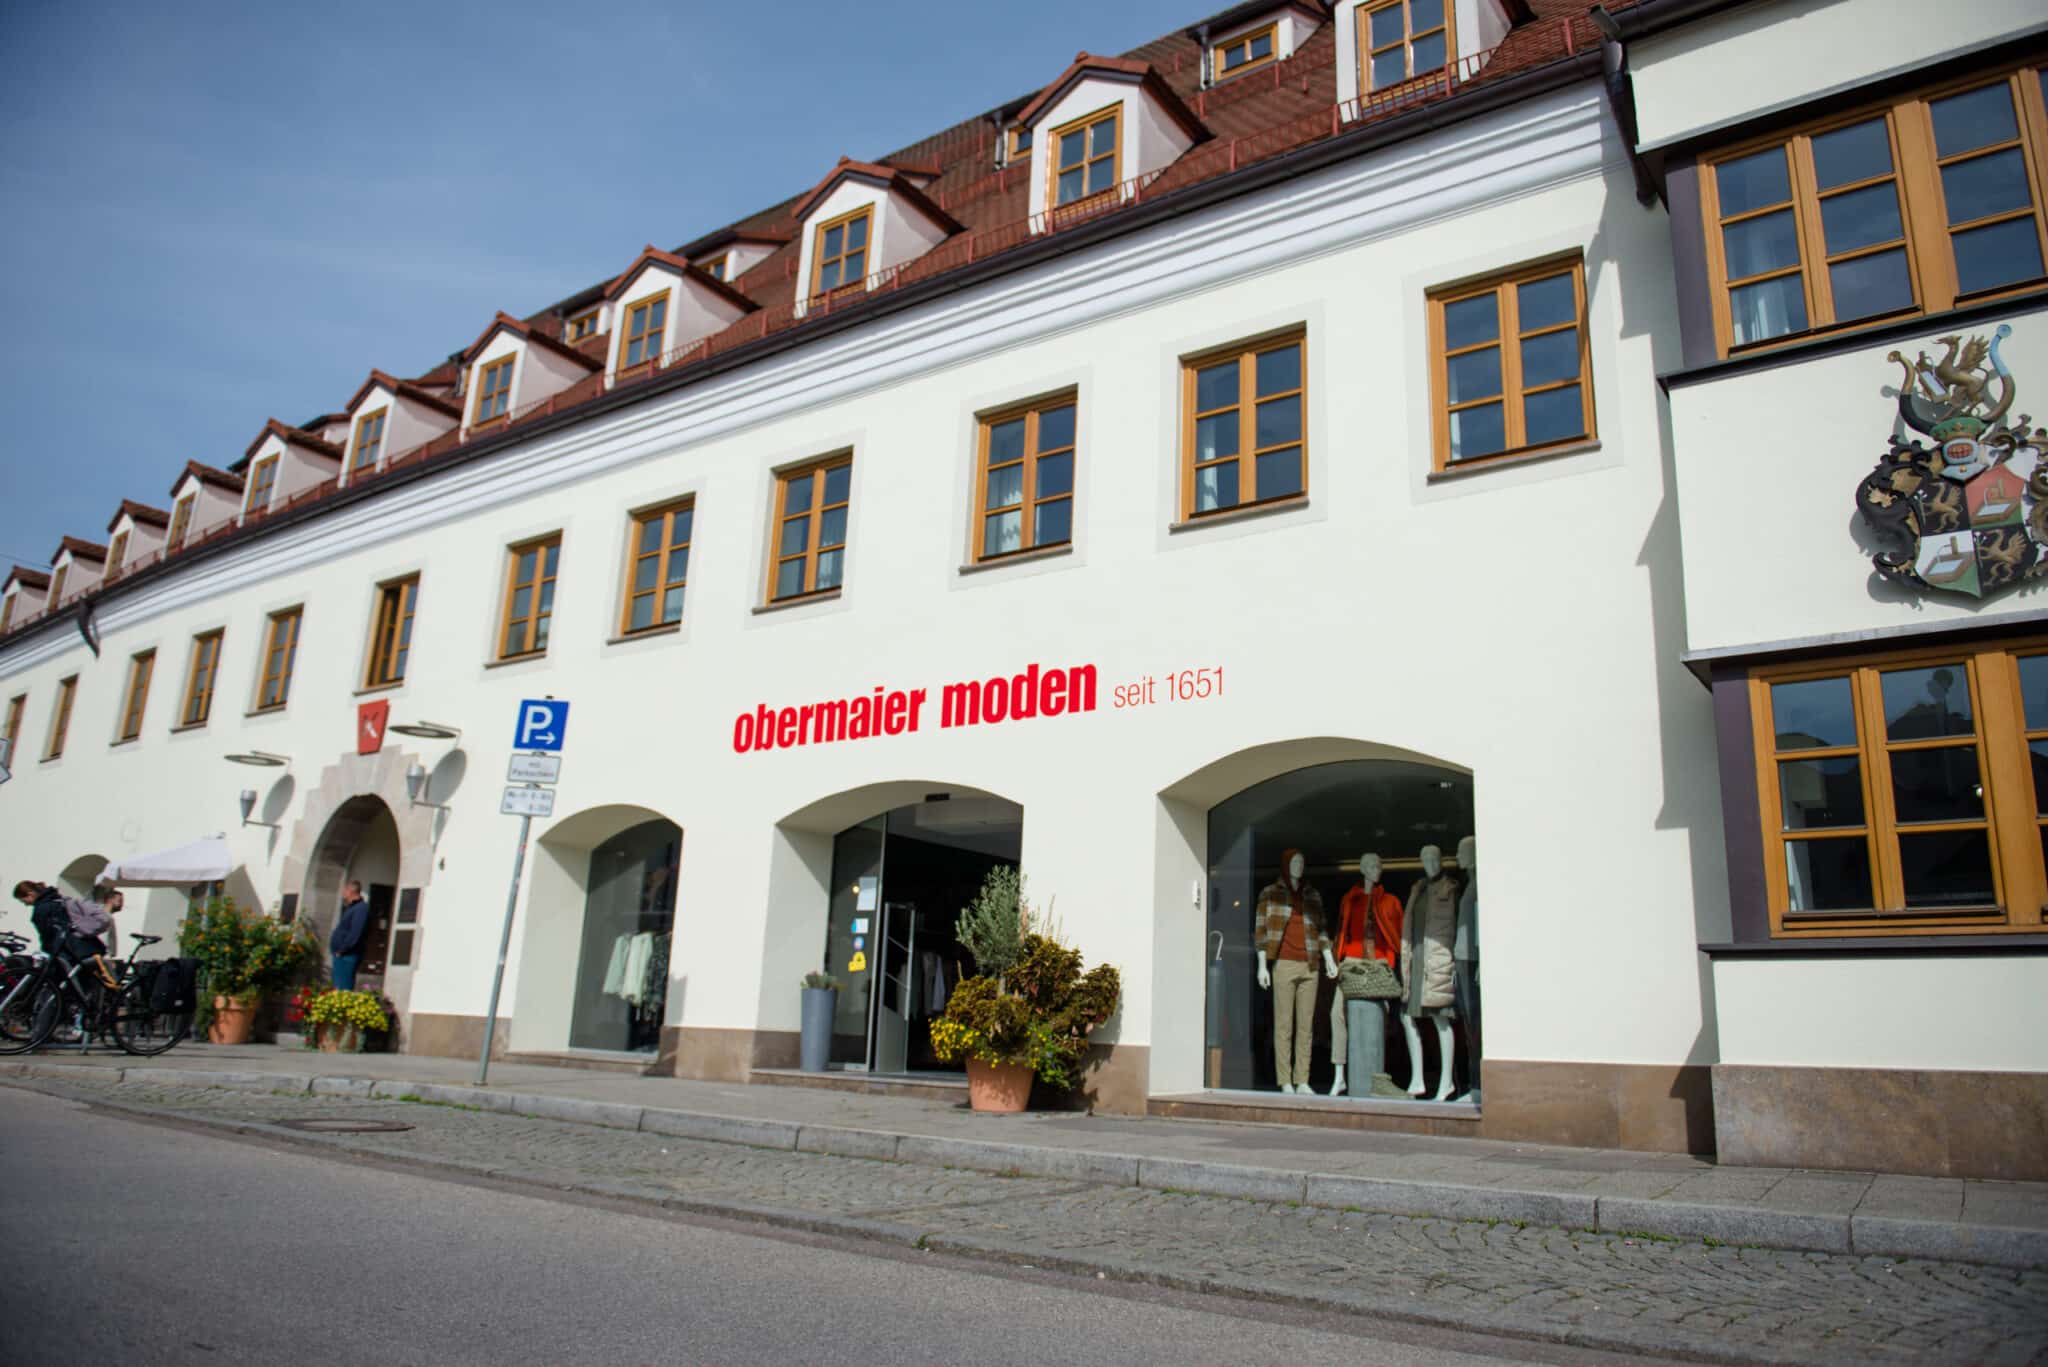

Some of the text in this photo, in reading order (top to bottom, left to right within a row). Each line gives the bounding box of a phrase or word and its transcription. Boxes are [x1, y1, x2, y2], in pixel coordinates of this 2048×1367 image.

[521, 704, 553, 744] P
[732, 662, 1224, 755] obermaier moden seit 1651
